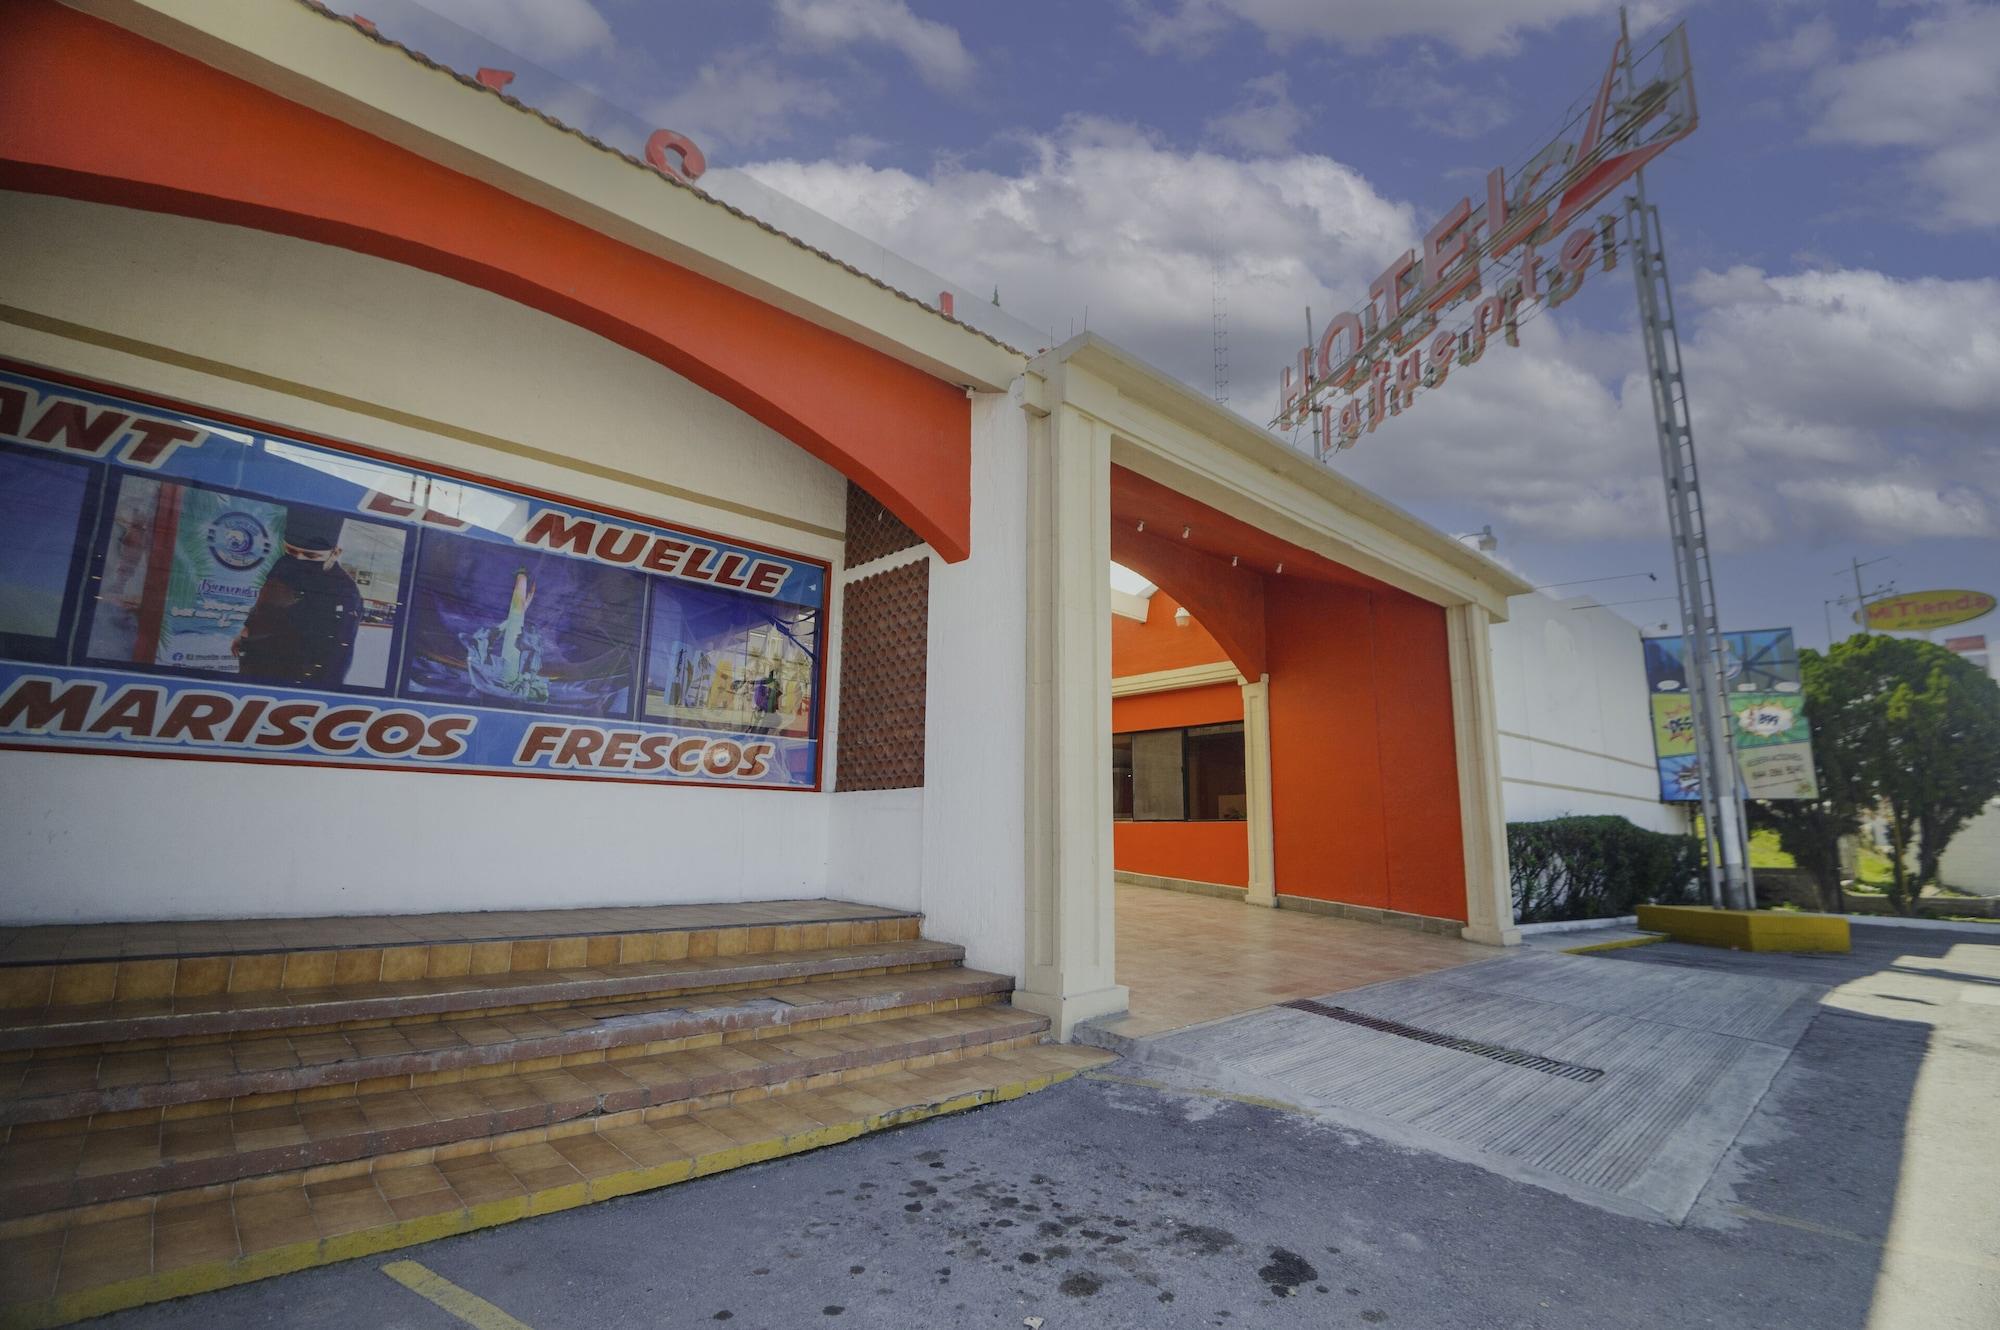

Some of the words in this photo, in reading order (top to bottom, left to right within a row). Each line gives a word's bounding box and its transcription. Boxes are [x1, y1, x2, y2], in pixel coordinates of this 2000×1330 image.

[1279, 165, 1549, 432] HOTEL
[522, 511, 791, 596] MUELLE
[0, 679, 473, 758] MARISCOS
[516, 724, 773, 777] FRESCOS
